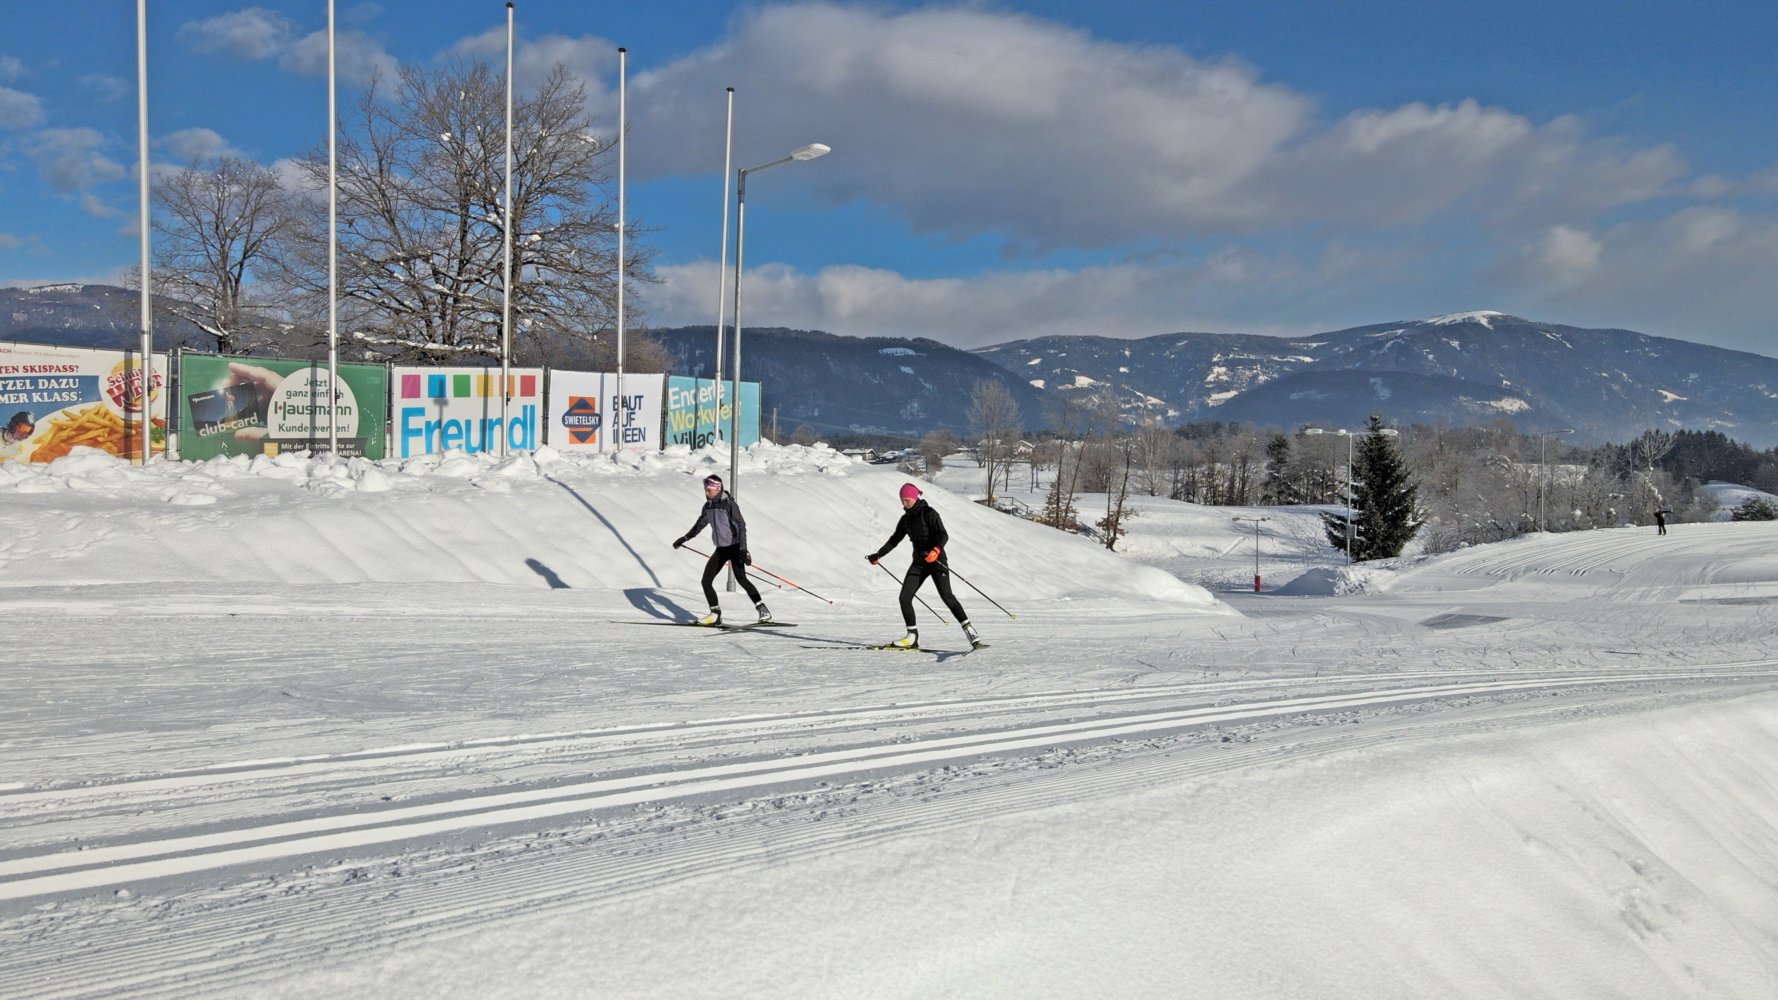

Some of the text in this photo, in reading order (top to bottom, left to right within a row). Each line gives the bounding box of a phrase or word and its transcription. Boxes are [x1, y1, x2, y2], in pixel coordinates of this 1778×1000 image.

[22, 364, 80, 374] SKISPASS?
[37, 378, 79, 390] DAZU
[303, 377, 328, 387] Jetzt
[285, 390, 309, 400] ganz
[199, 411, 259, 437] club-card
[564, 415, 600, 426] SWIETELSKY
[278, 423, 350, 433] Kunde weren!
[401, 404, 536, 459] Freundl
